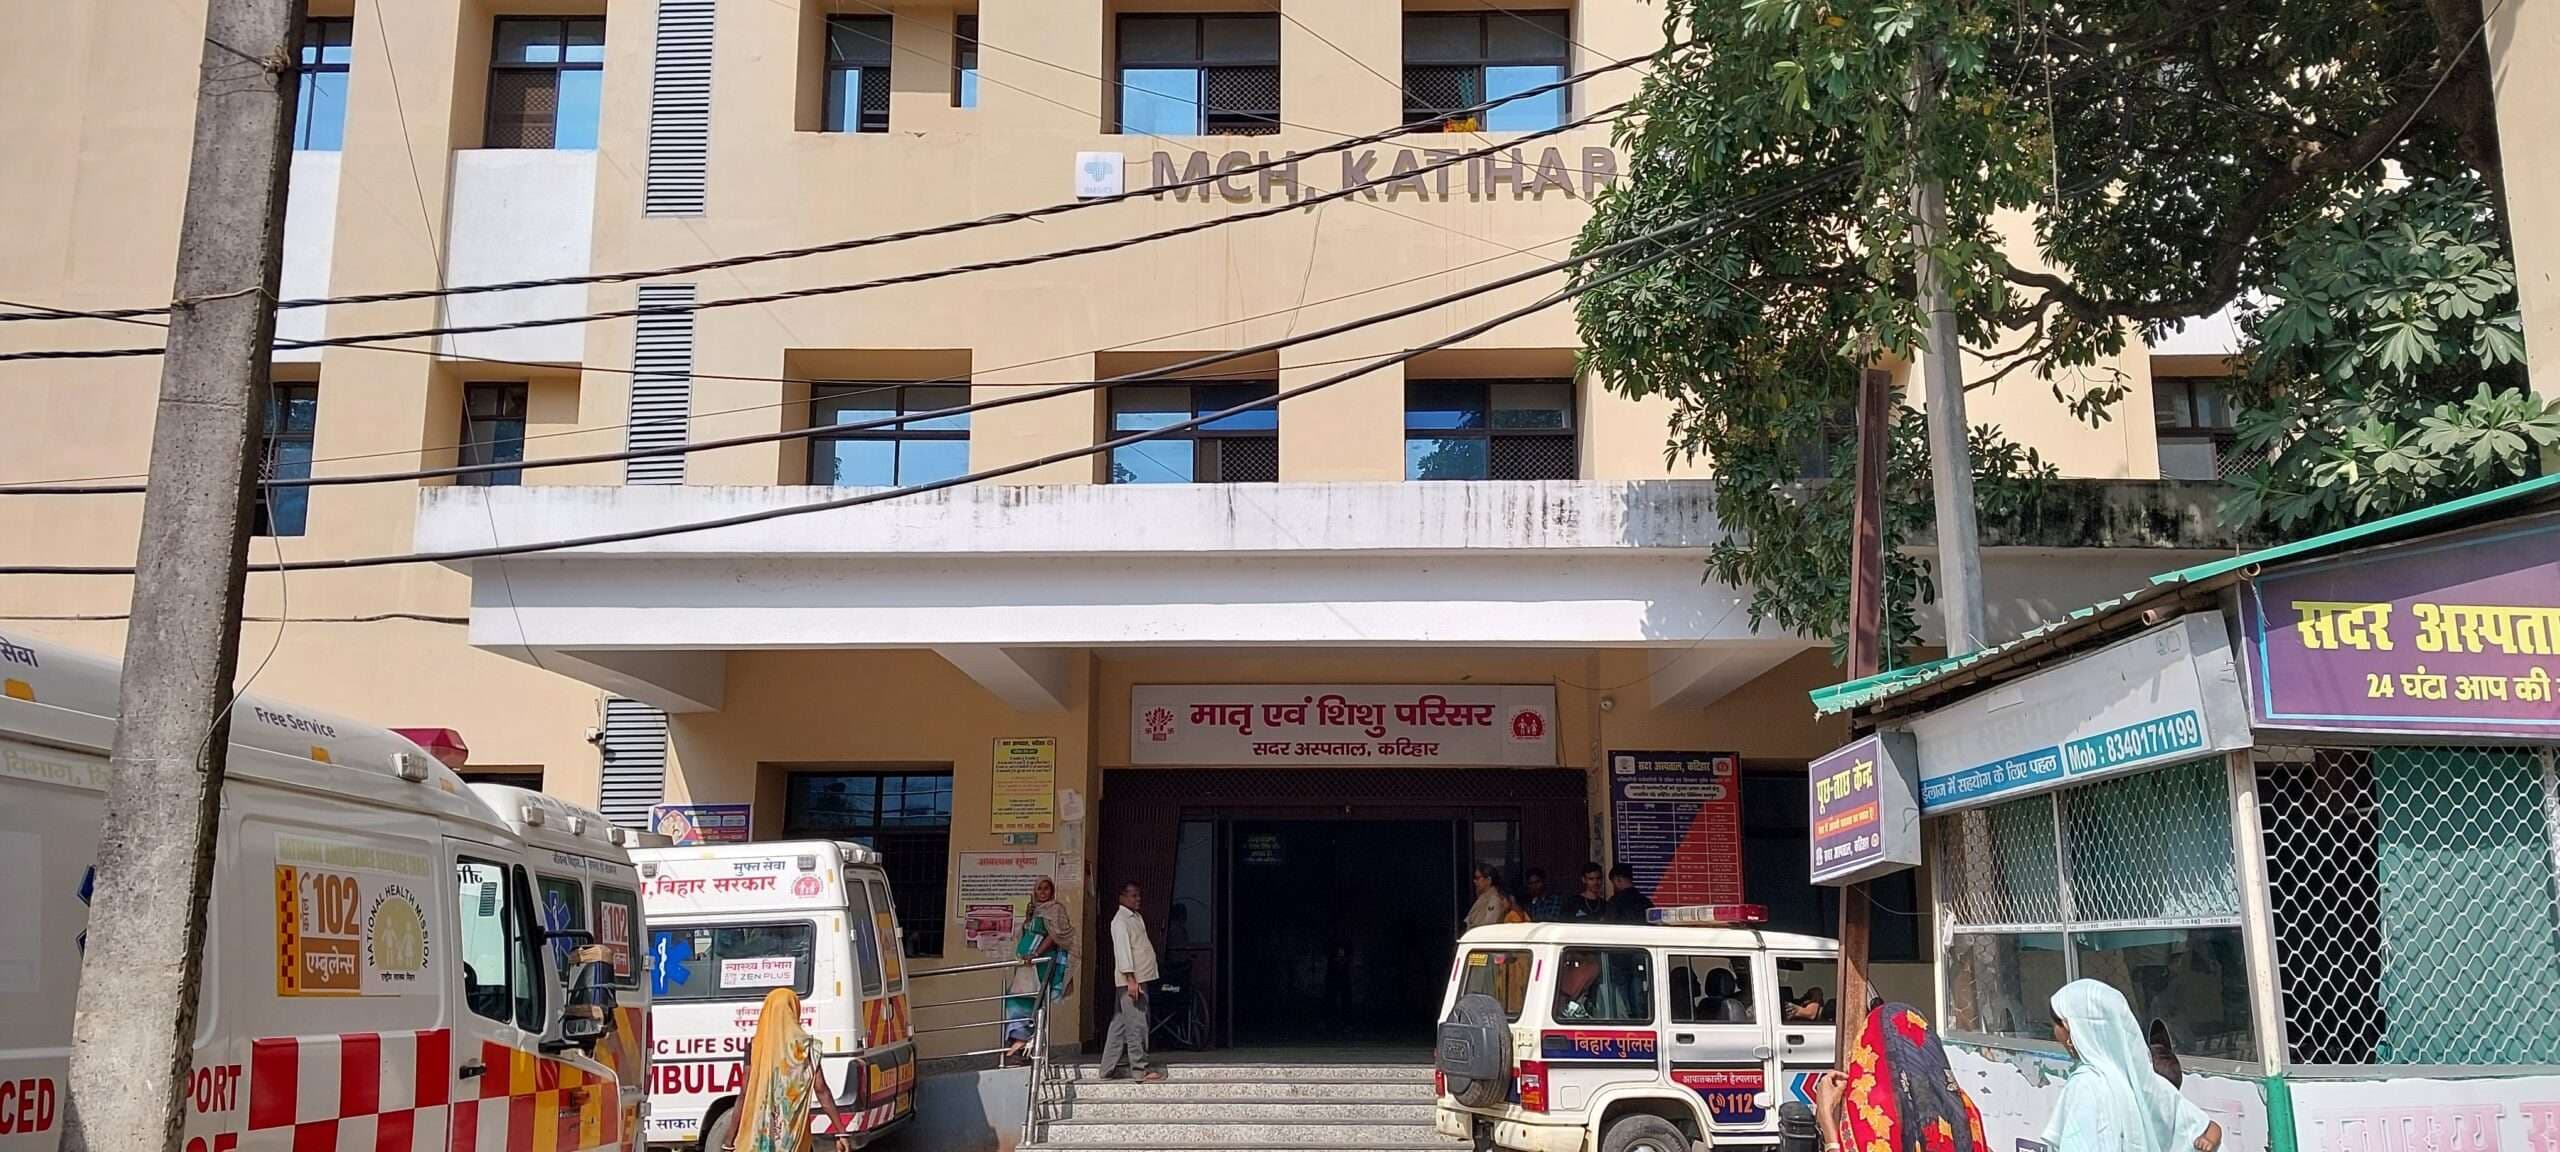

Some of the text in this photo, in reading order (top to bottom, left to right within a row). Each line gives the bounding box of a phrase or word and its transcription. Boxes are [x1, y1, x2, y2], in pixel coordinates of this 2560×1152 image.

[1152, 146, 1618, 214] MCH, KATIHAR
[2291, 600, 2560, 655] सदर अस्पता
[2366, 665, 2552, 702] 24 घंटा आप की
[255, 706, 336, 738] Free Service
[1190, 694, 1495, 737] मातृ एवं शिशु परिसर
[1253, 738, 1439, 758] सदर अस्पताल, कटिहार
[2067, 744, 2097, 772] Mob
[2105, 714, 2198, 762] 8340171199
[1946, 775, 1957, 794] में
[1957, 770, 1992, 793] सहयोग
[1994, 764, 2004, 784] के
[2006, 760, 2027, 782] लिए
[2028, 754, 2057, 775] पहल
[713, 875, 776, 892] सरकार
[733, 858, 785, 876] मुफ्त सेवा
[313, 873, 360, 935] 102
[366, 884, 430, 969] NATIONAL HEALTH MISSION
[608, 905, 628, 943] 102
[676, 1038, 715, 1053] LIFE
[1574, 1032, 1655, 1058] बिहार पुलिस
[1728, 1093, 1753, 1114] 112
